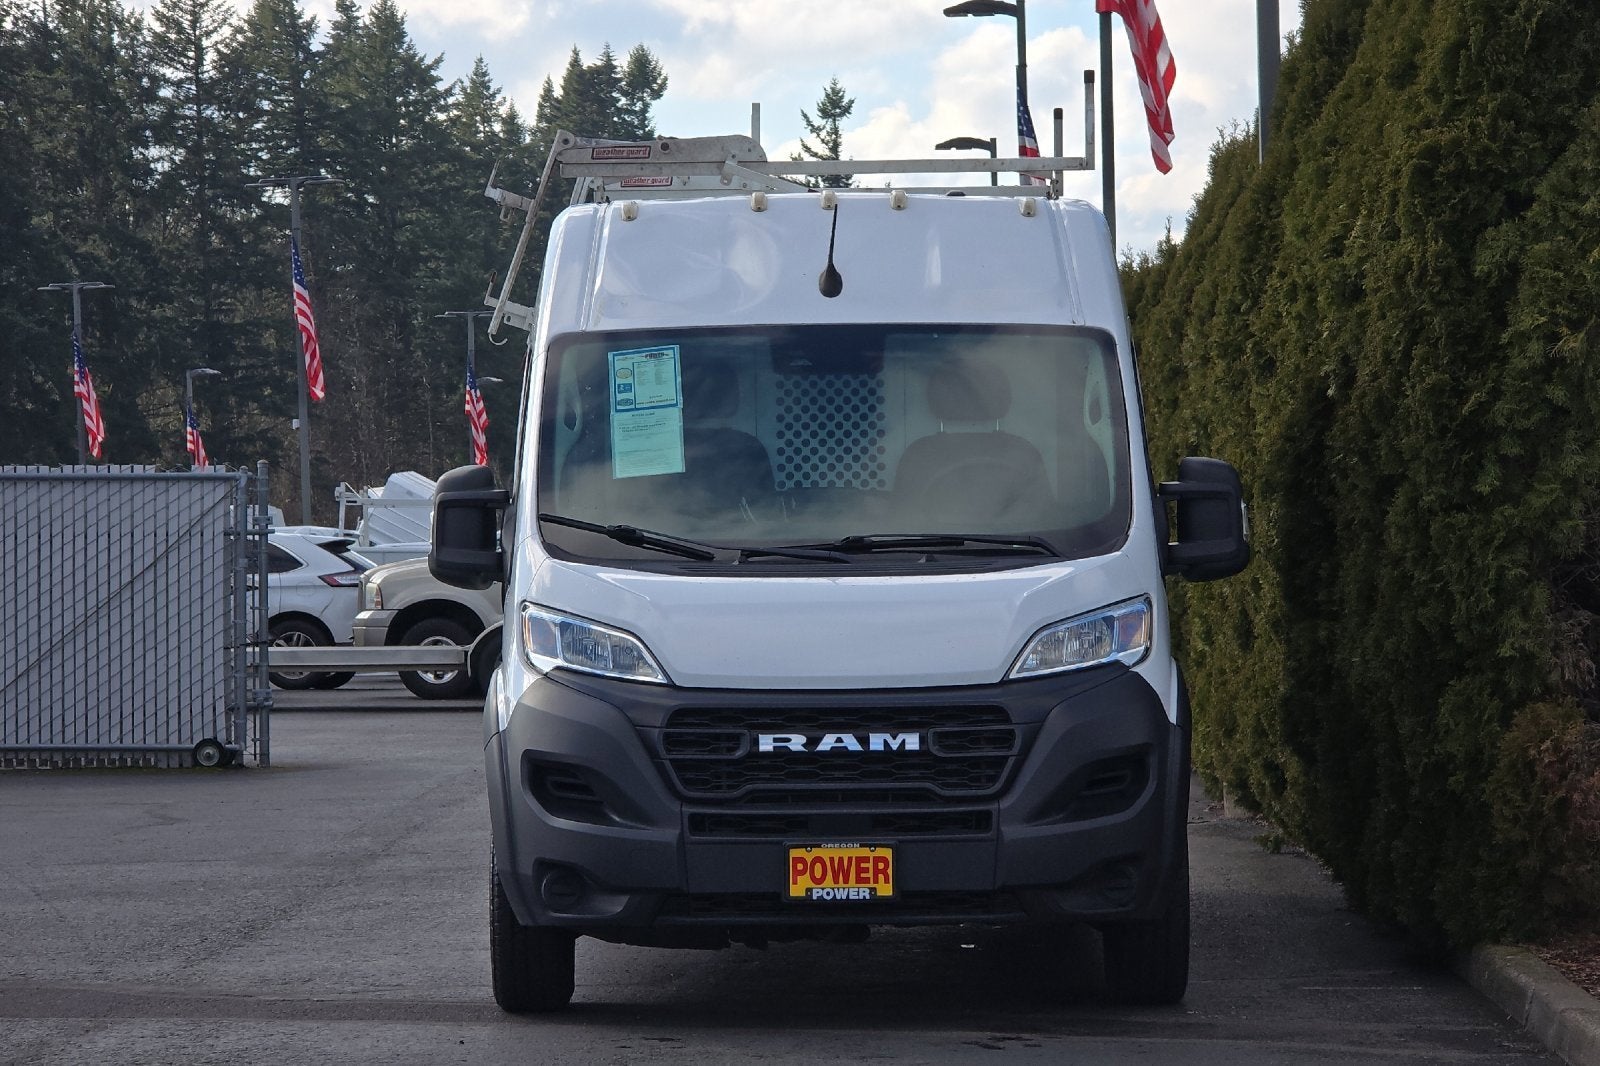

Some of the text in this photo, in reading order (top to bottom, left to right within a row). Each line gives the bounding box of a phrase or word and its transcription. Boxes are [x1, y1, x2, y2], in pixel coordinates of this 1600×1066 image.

[626, 147, 648, 156] guard
[758, 733, 920, 753] RAM
[791, 856, 890, 886] POWER
[812, 888, 871, 900] POWER
